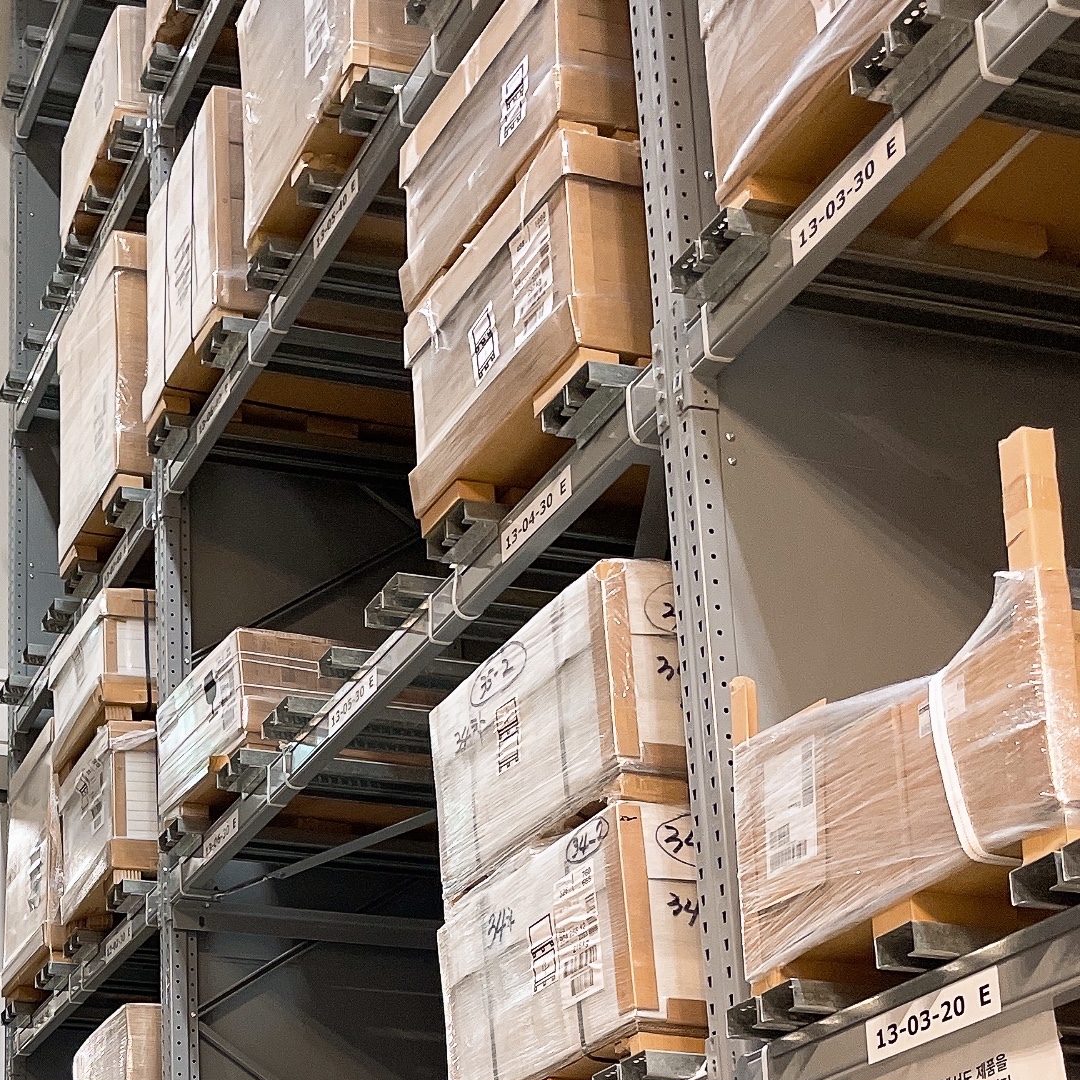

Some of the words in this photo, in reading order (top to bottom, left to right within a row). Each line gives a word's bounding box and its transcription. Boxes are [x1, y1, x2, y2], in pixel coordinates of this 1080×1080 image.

[798, 159, 875, 248] 13-03-30
[886, 136, 897, 159] E
[505, 492, 553, 550] 13-04-30
[560, 478, 567, 495] E
[331, 685, 365, 728] 13-05-30
[369, 674, 374, 689] E
[876, 995, 965, 1049] 13-03-20
[979, 983, 991, 1006] E
[976, 1053, 1008, 1080] 제품을
